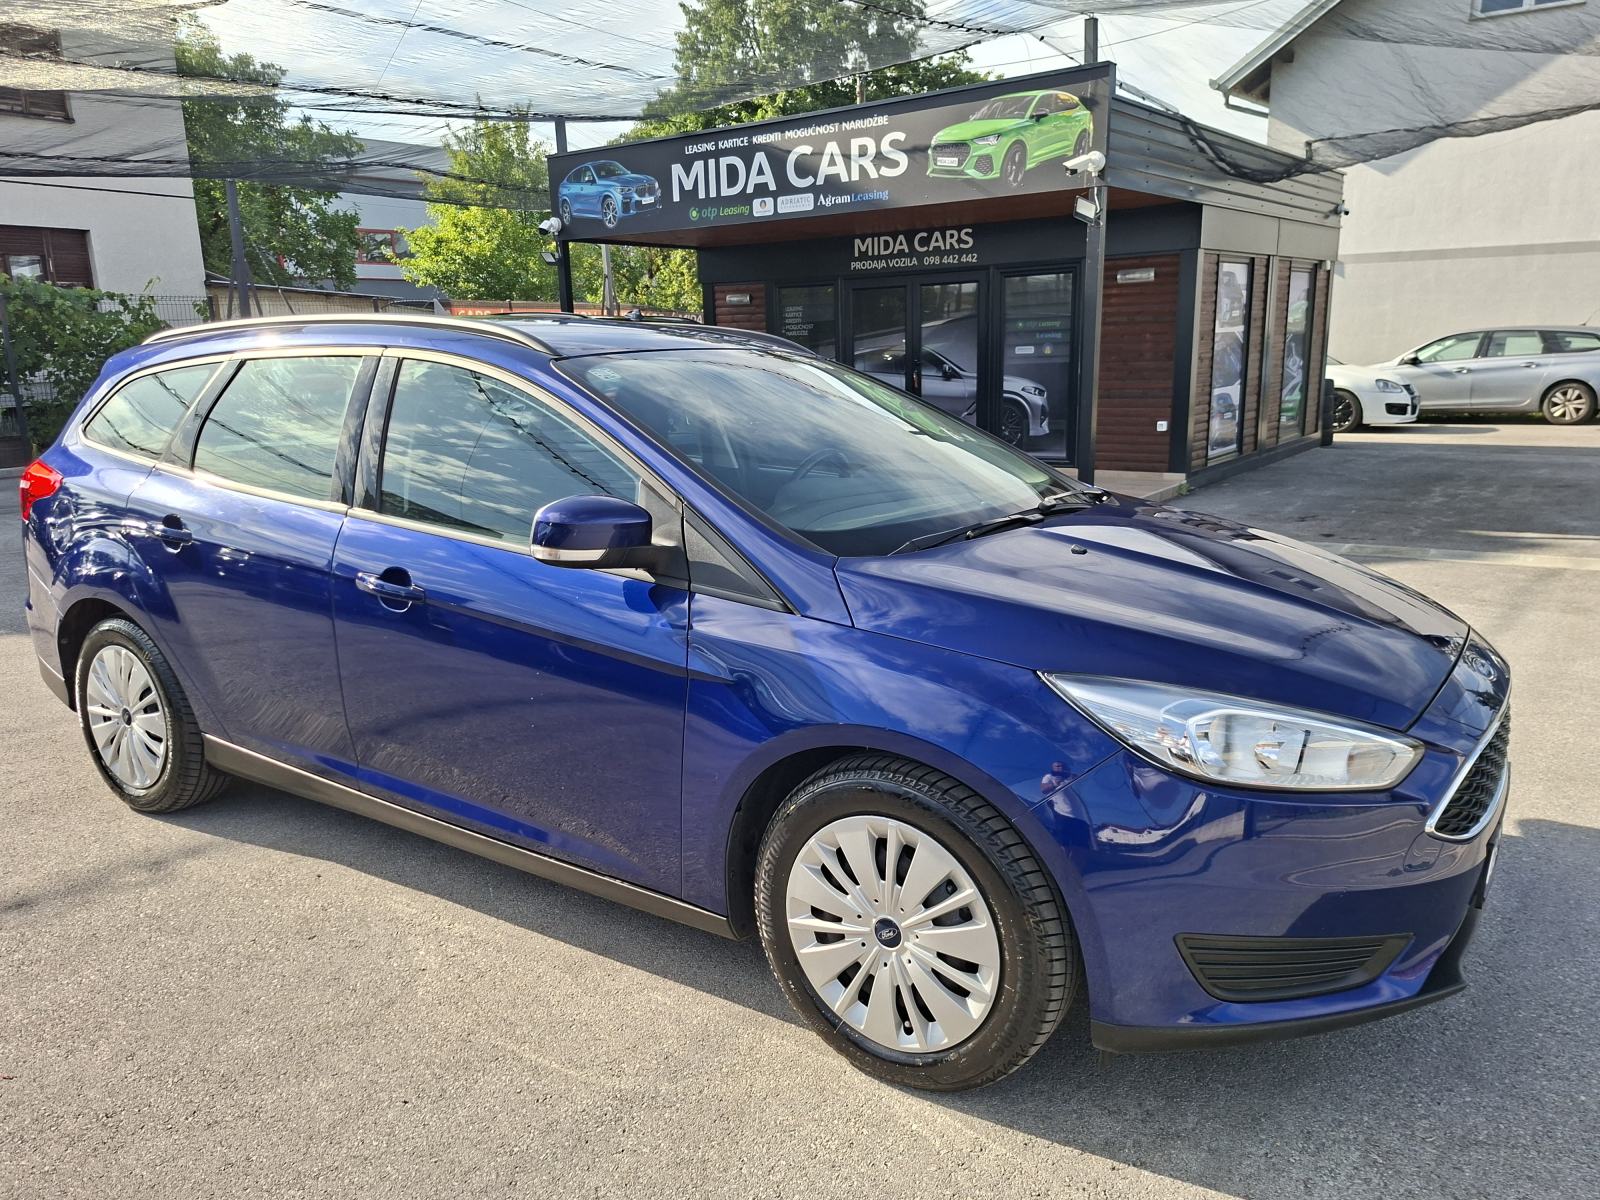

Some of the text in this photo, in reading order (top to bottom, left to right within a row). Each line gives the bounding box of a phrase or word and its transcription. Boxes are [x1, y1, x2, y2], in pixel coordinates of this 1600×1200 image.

[685, 114, 889, 154] LEASING KARTICE KREDITI MOGUĆNOST NARUDŽBE
[671, 131, 909, 202] MIDA CARS
[702, 205, 750, 220] otp Leasing
[854, 228, 974, 257] MIDA CARS
[850, 253, 978, 270] PRODAJA VOZILA 098 442 442
